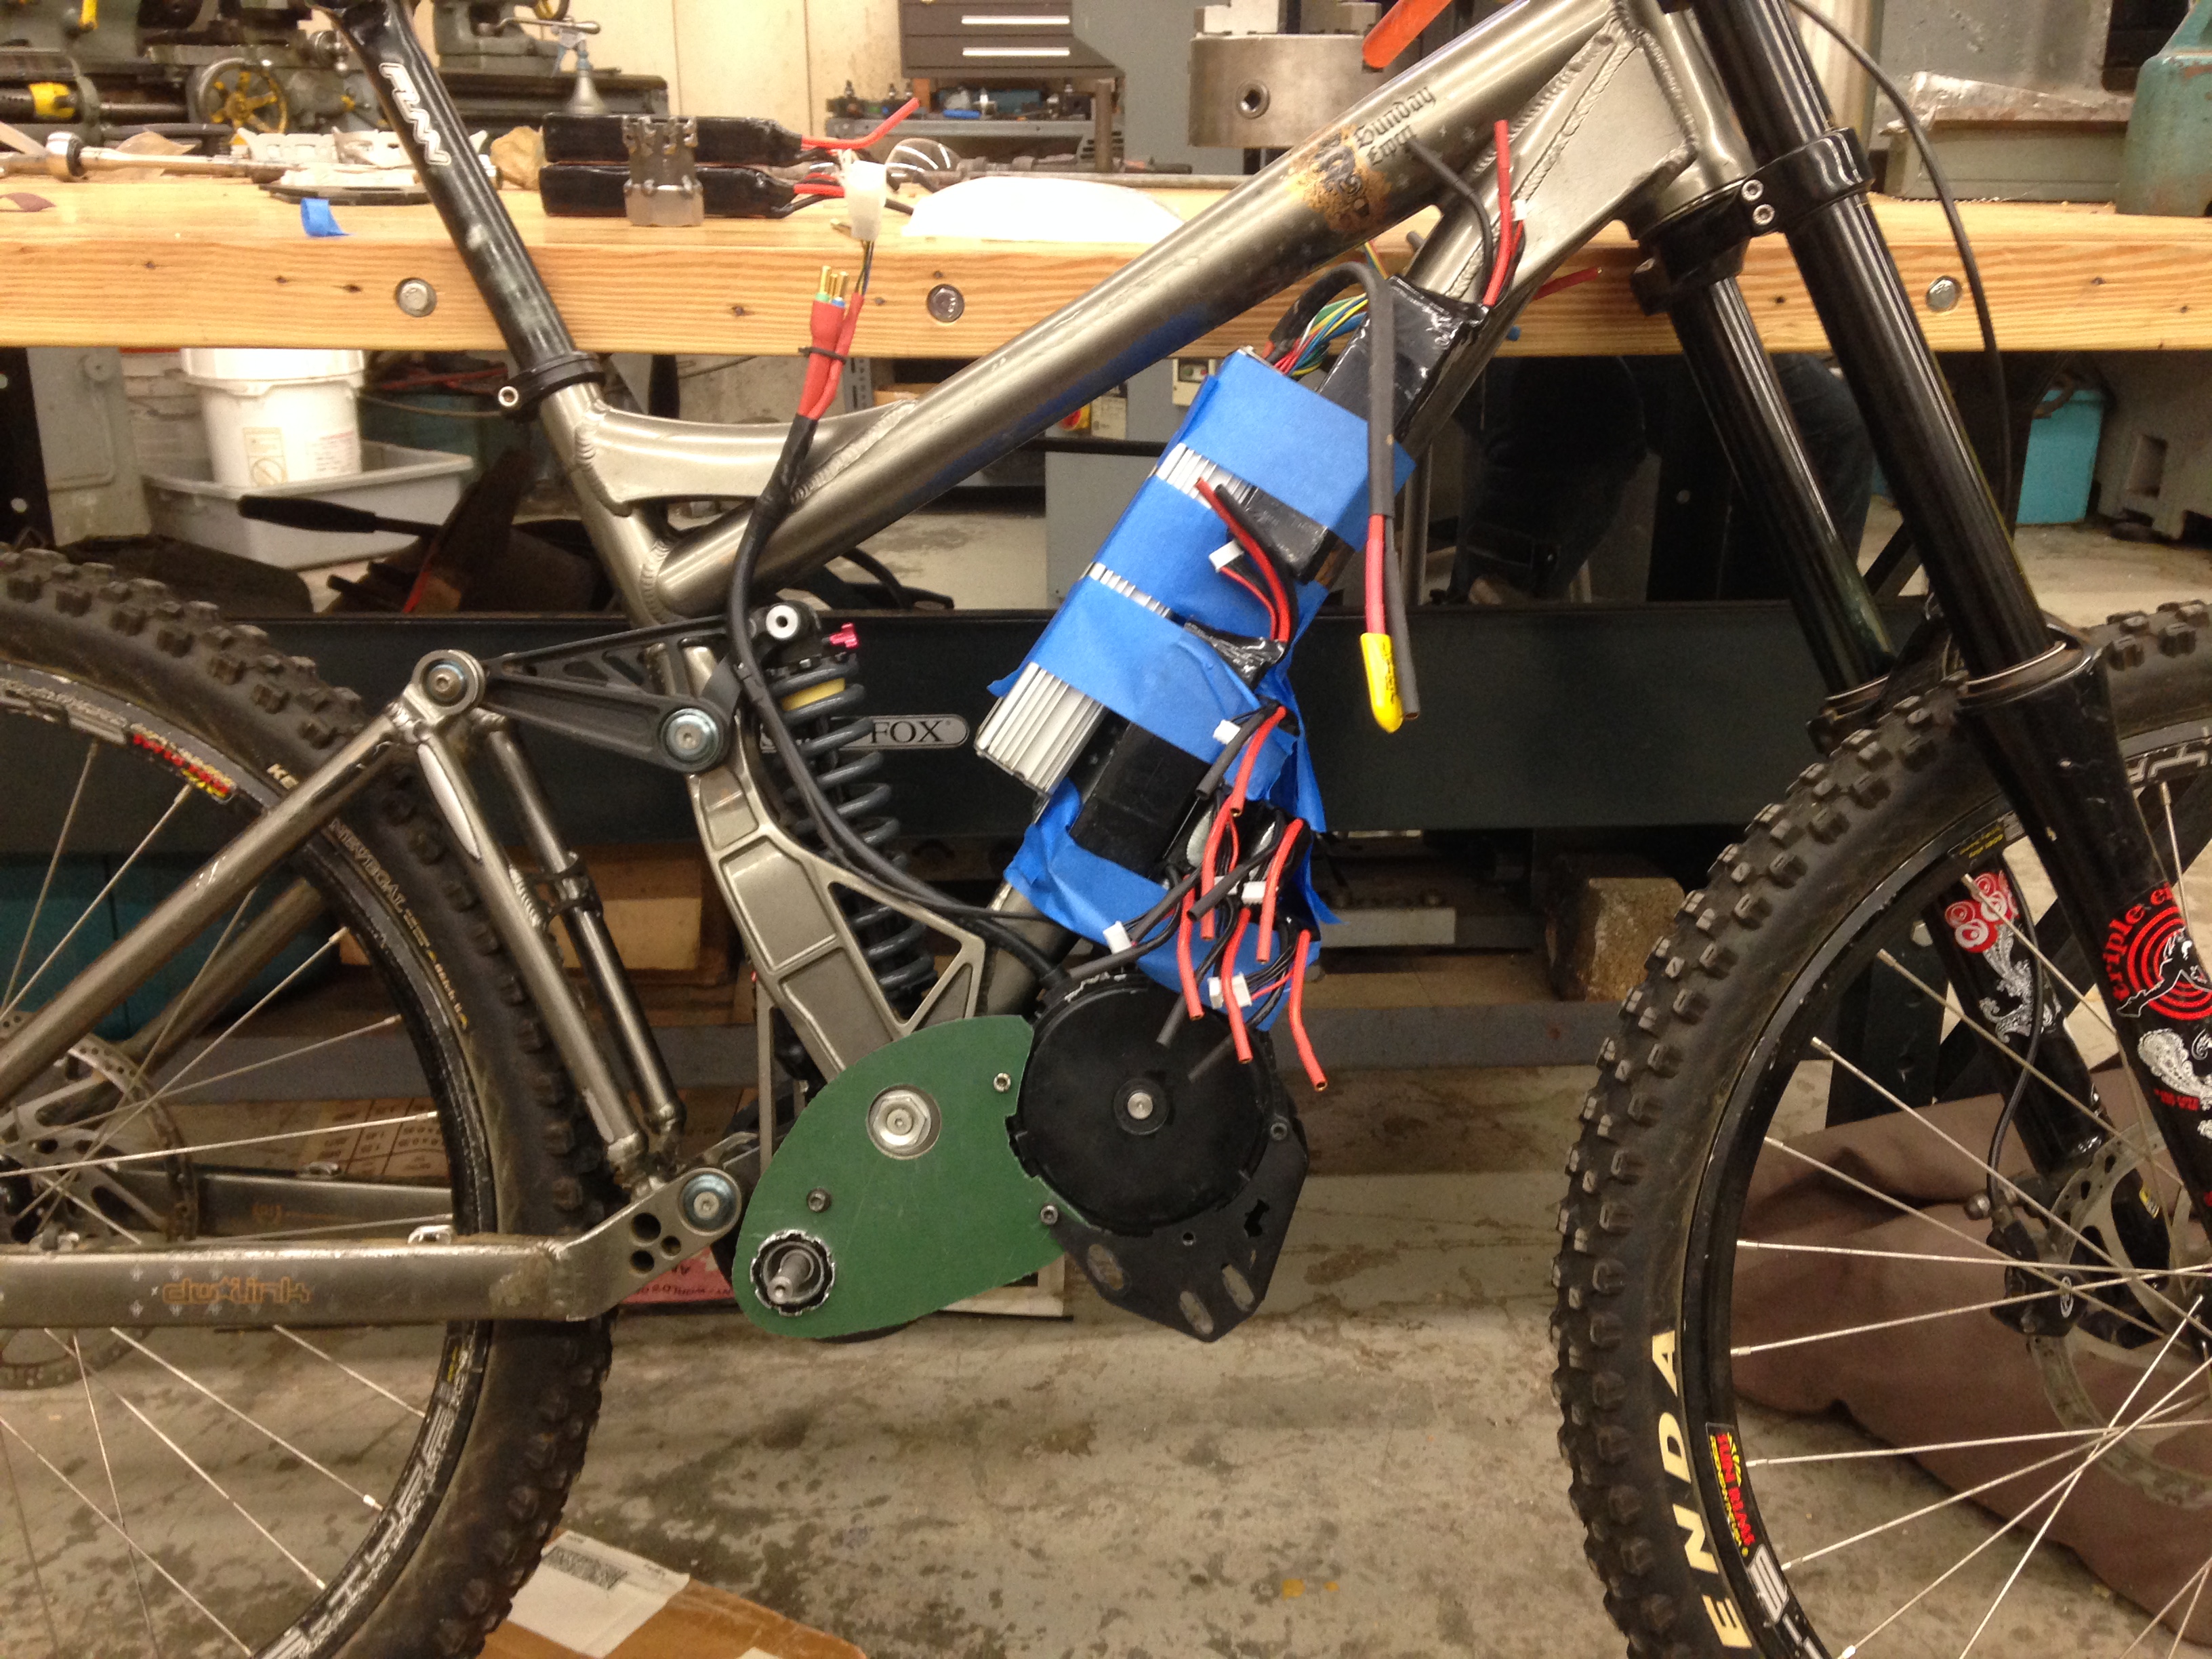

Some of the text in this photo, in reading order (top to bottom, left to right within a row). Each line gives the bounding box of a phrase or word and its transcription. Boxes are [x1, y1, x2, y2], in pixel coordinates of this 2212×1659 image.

[1354, 86, 1436, 149] Sunday
[871, 720, 943, 744] FOX
[2103, 904, 2146, 1002] triple
[1716, 1433, 1736, 1482] SUN
